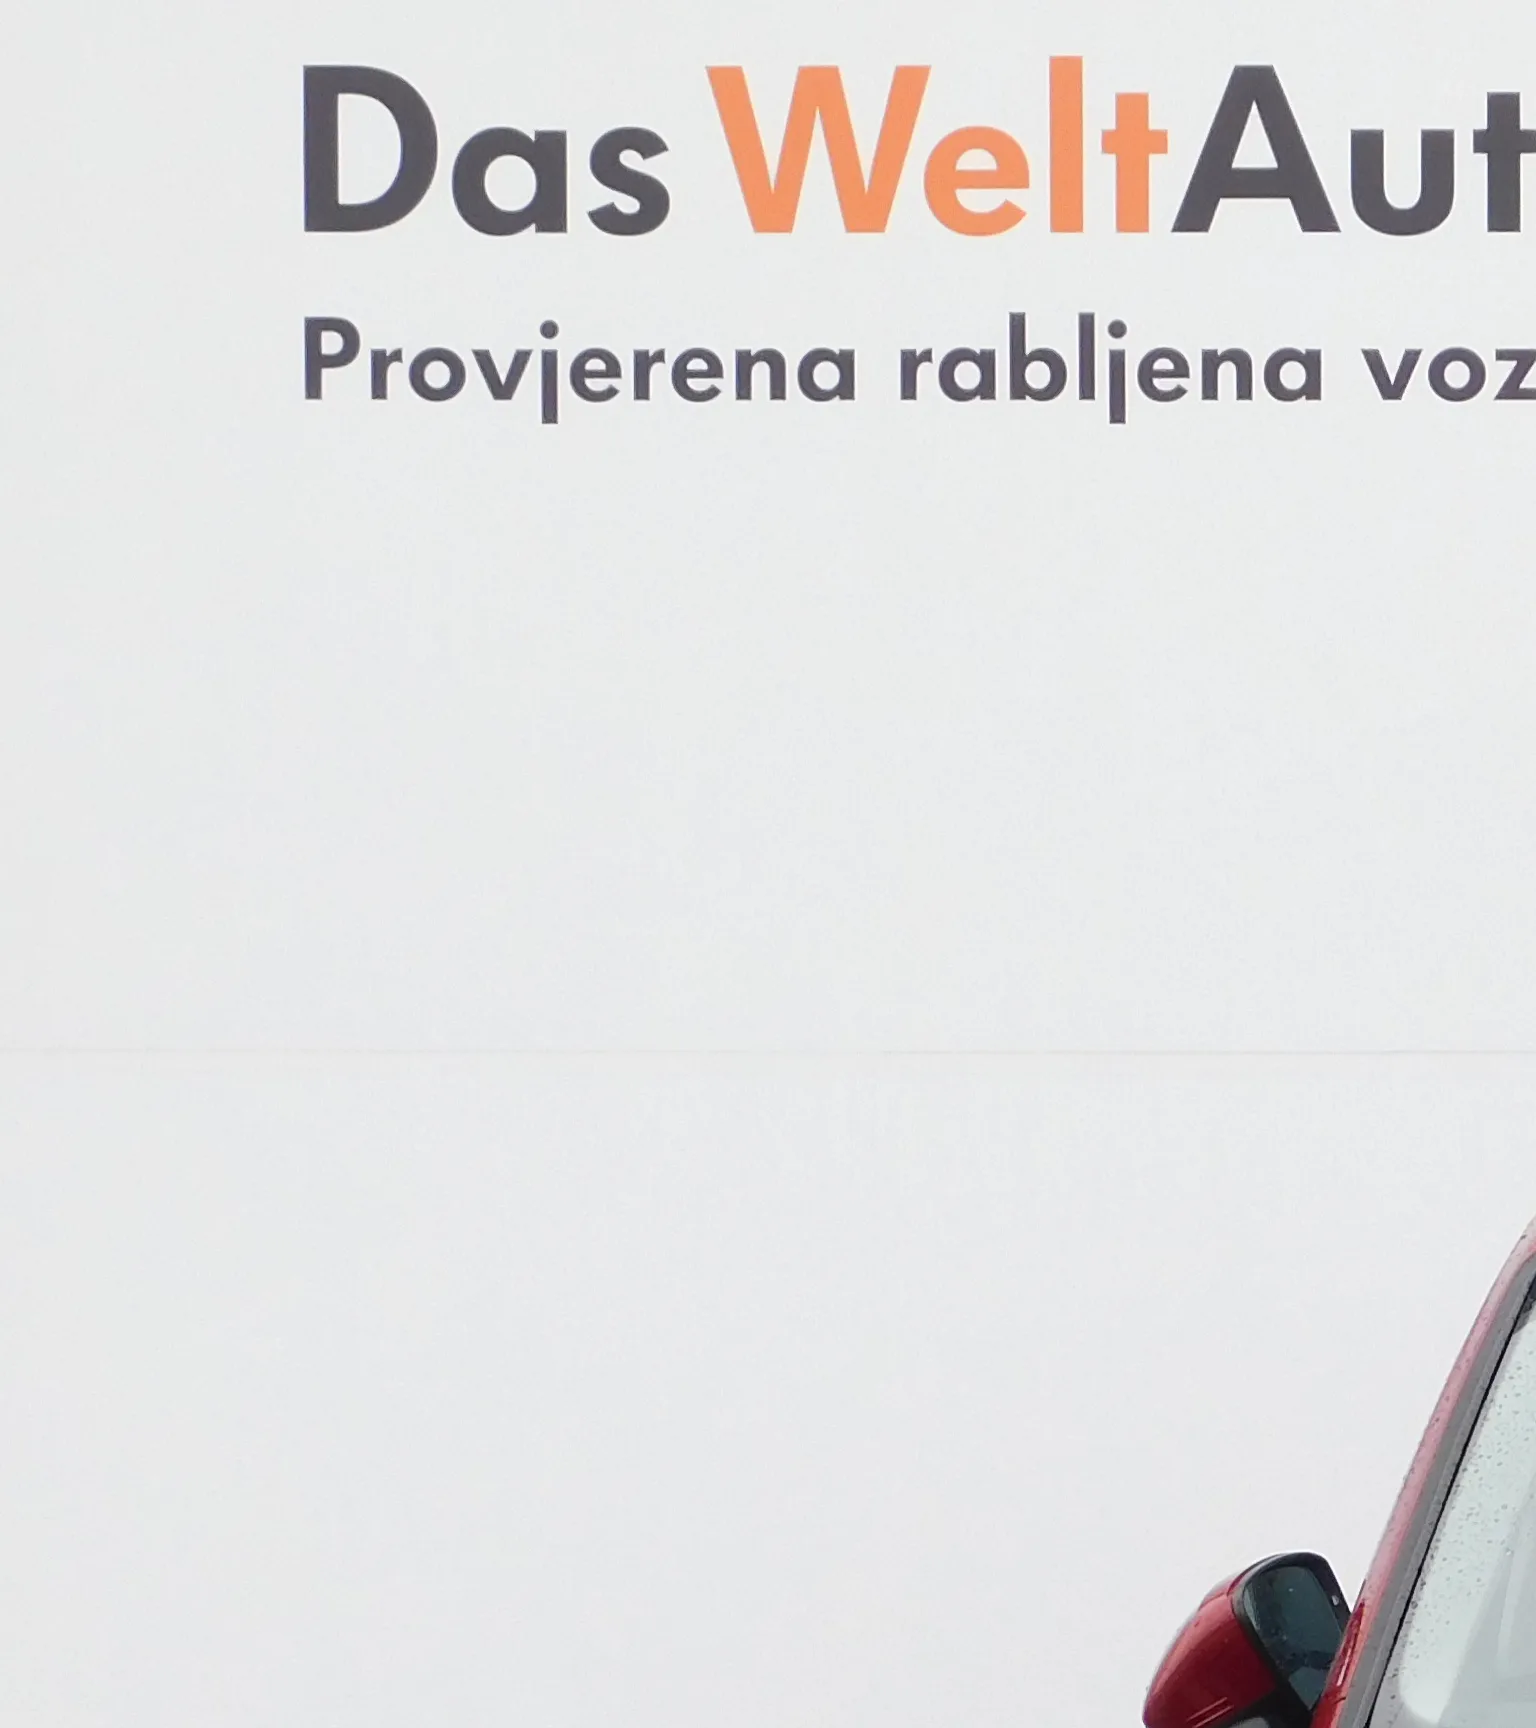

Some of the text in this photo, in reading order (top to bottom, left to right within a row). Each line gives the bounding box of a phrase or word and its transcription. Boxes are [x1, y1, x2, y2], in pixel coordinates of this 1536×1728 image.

[303, 66, 671, 237] Das
[304, 316, 856, 425] Provjerena
[899, 312, 1323, 424] rabljena
